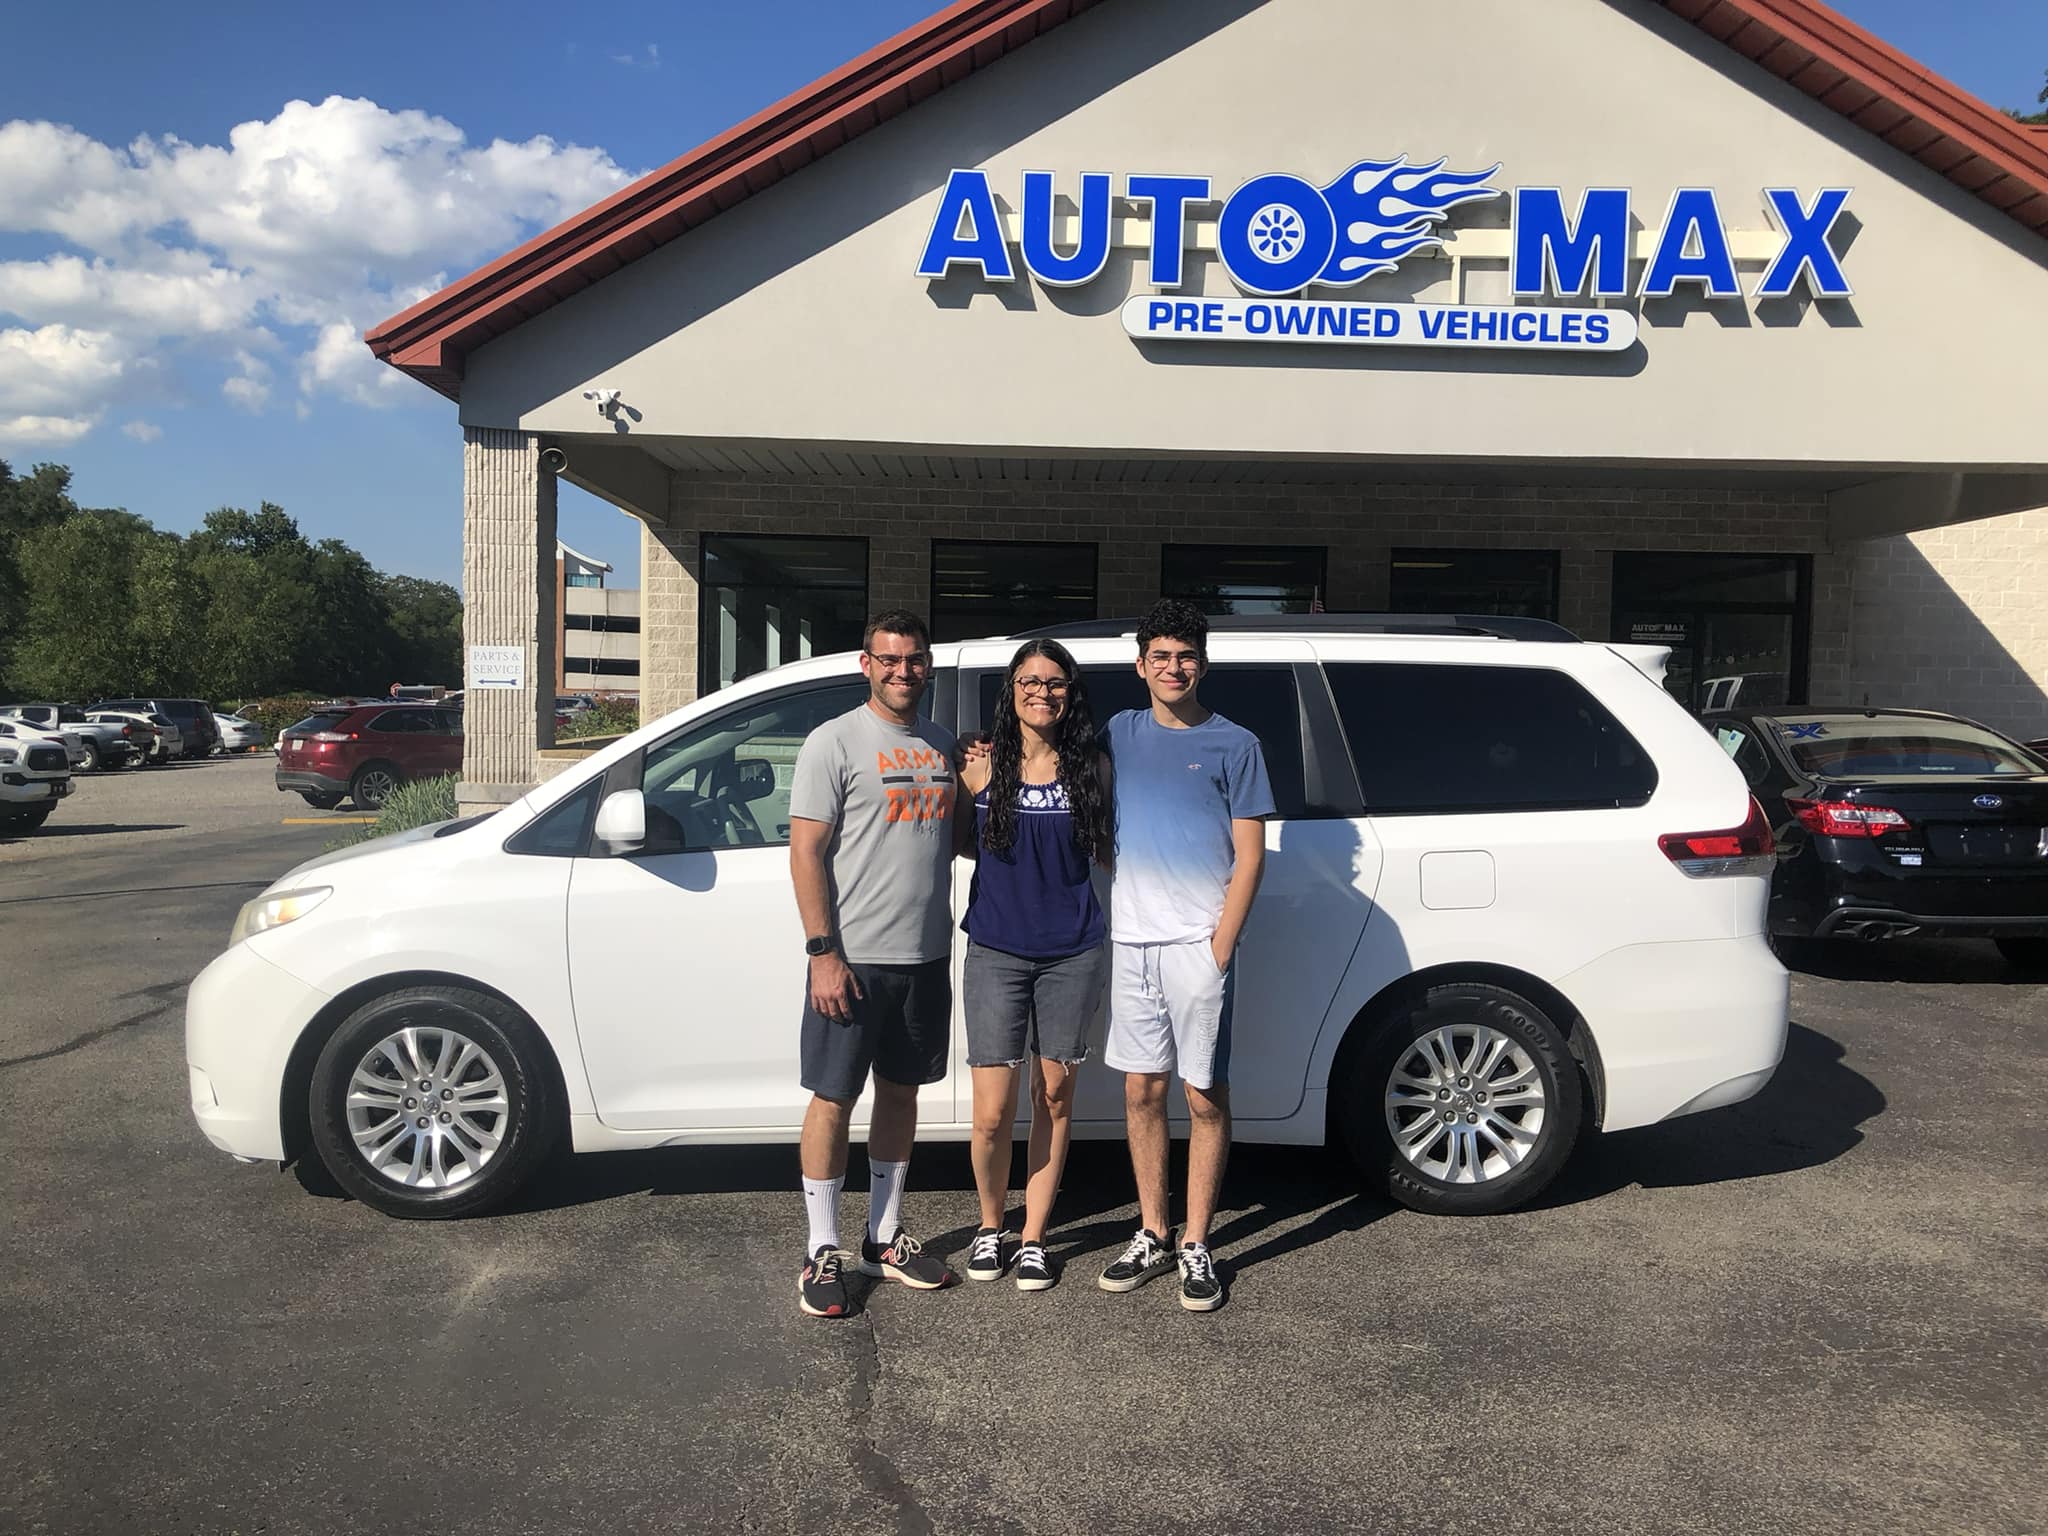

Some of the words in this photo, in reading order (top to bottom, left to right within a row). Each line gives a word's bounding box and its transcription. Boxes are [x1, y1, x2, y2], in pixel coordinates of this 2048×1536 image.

[914, 168, 1337, 295] AUTO
[1510, 186, 1856, 299] MAX
[1148, 301, 1400, 338] PRE-OWNED
[1418, 309, 1610, 344] VEHICLES
[1664, 623, 1686, 633] MAX
[473, 651, 509, 661] PARTS
[511, 652, 520, 661] &
[473, 664, 521, 675] SERVICE
[877, 747, 949, 775] ARMY
